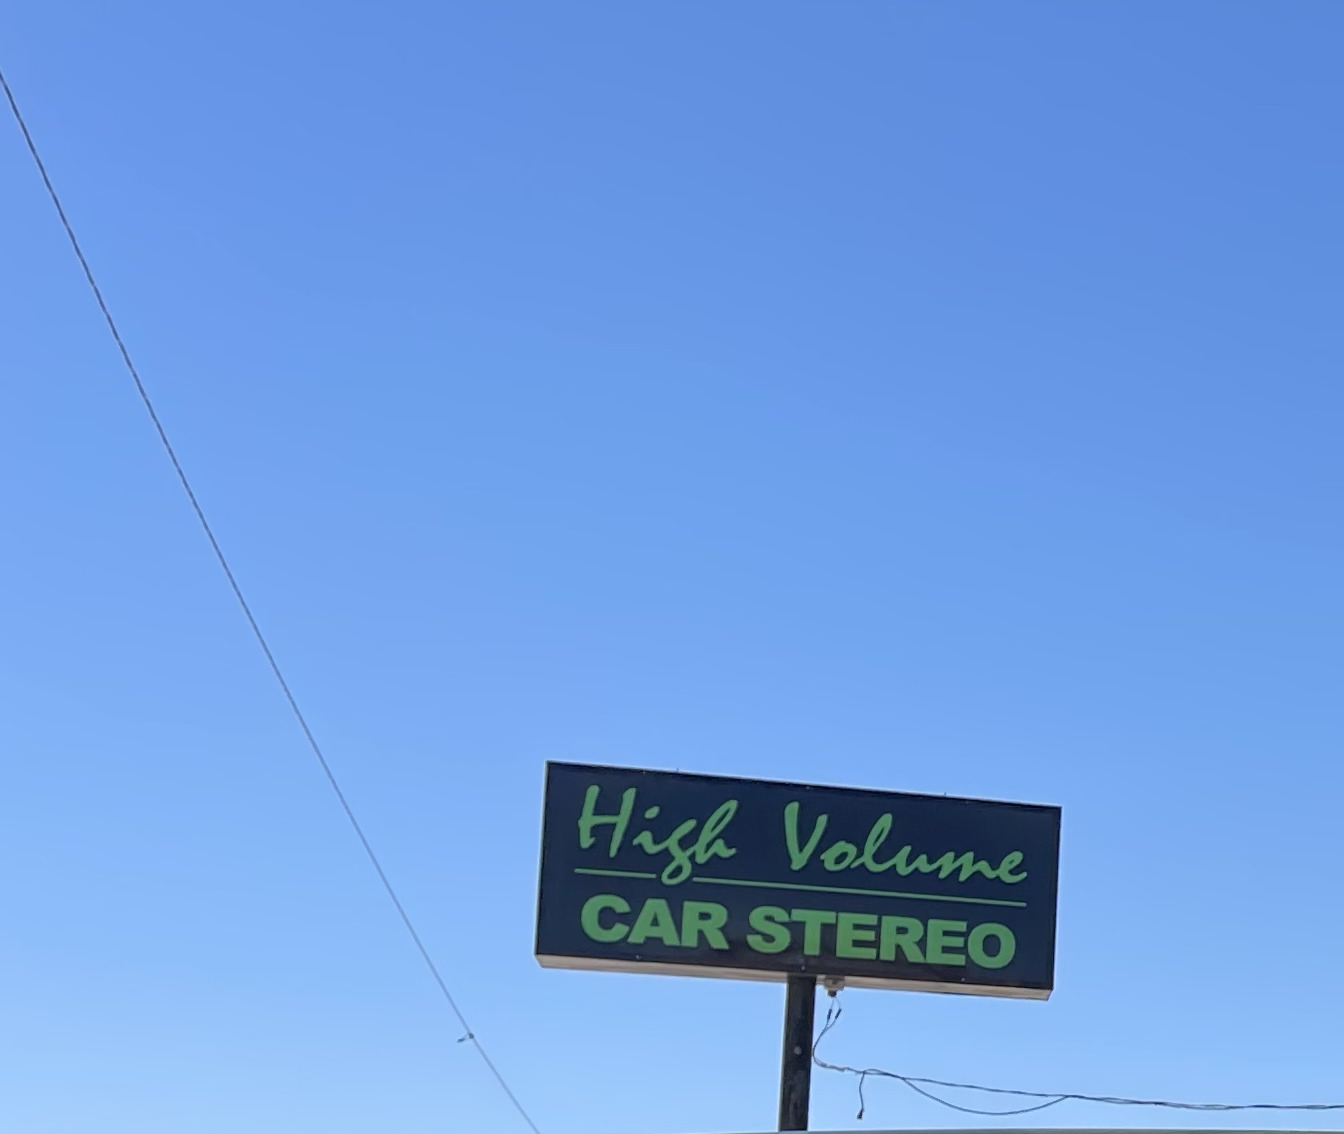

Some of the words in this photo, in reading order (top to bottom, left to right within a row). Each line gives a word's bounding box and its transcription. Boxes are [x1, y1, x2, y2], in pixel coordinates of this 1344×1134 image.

[577, 785, 739, 886] High
[783, 801, 1028, 884] Volume
[580, 894, 729, 950] CAR
[746, 905, 1017, 969] STEREO
